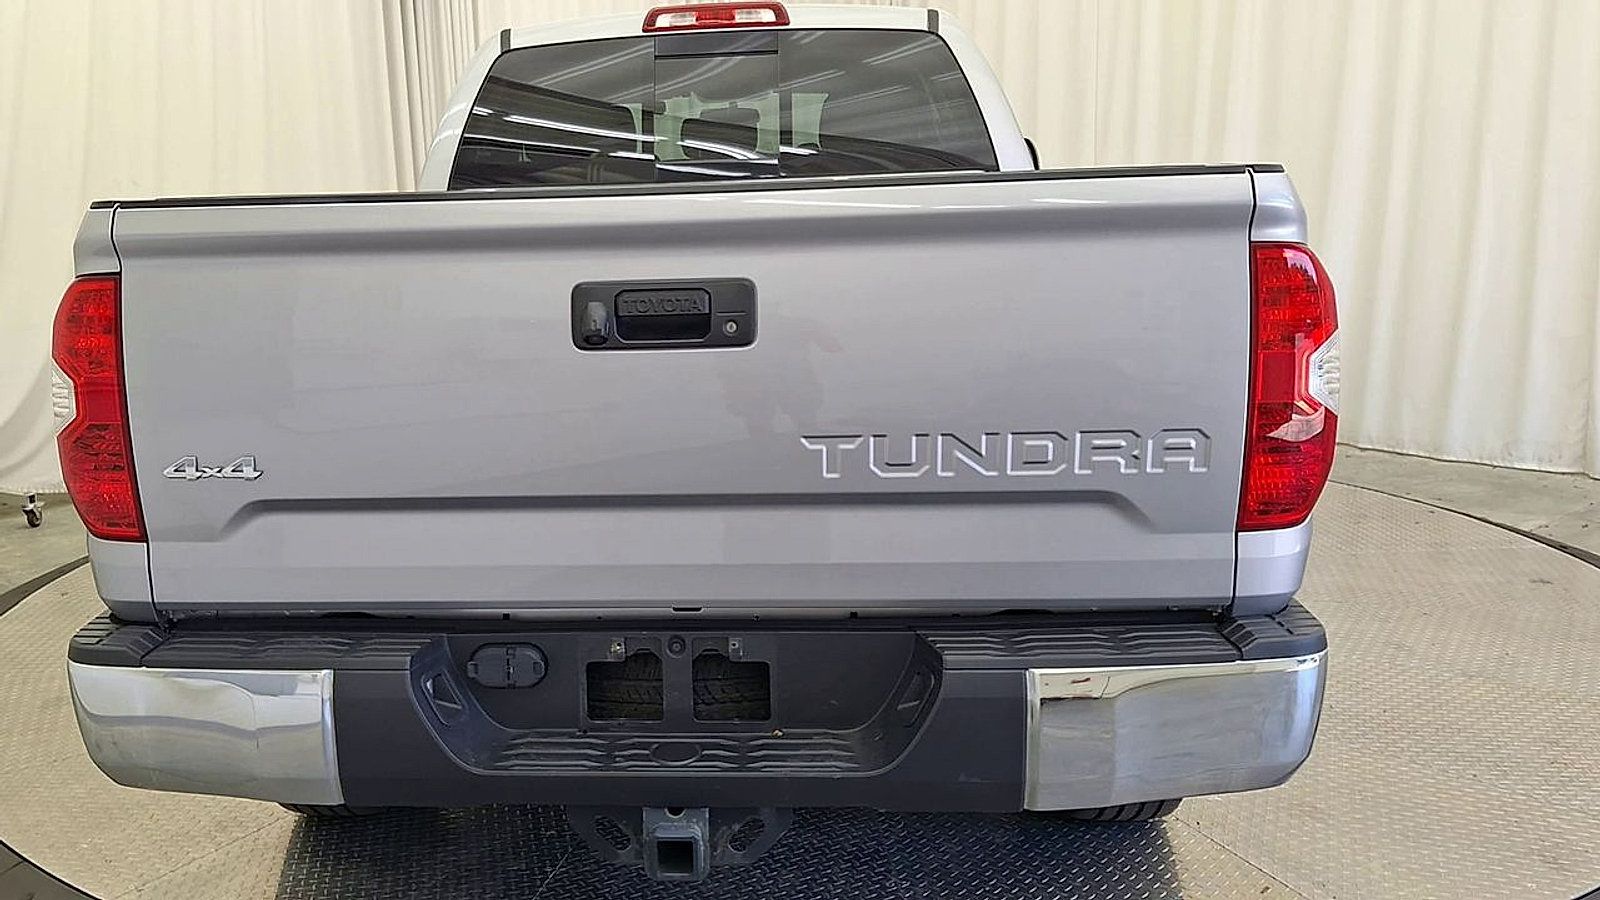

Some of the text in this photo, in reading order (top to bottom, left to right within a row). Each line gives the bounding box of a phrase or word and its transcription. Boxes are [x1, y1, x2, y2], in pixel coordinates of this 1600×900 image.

[622, 297, 704, 314] TOYOTA
[800, 428, 1211, 478] TUNDRA
[163, 455, 263, 480] 4x4
